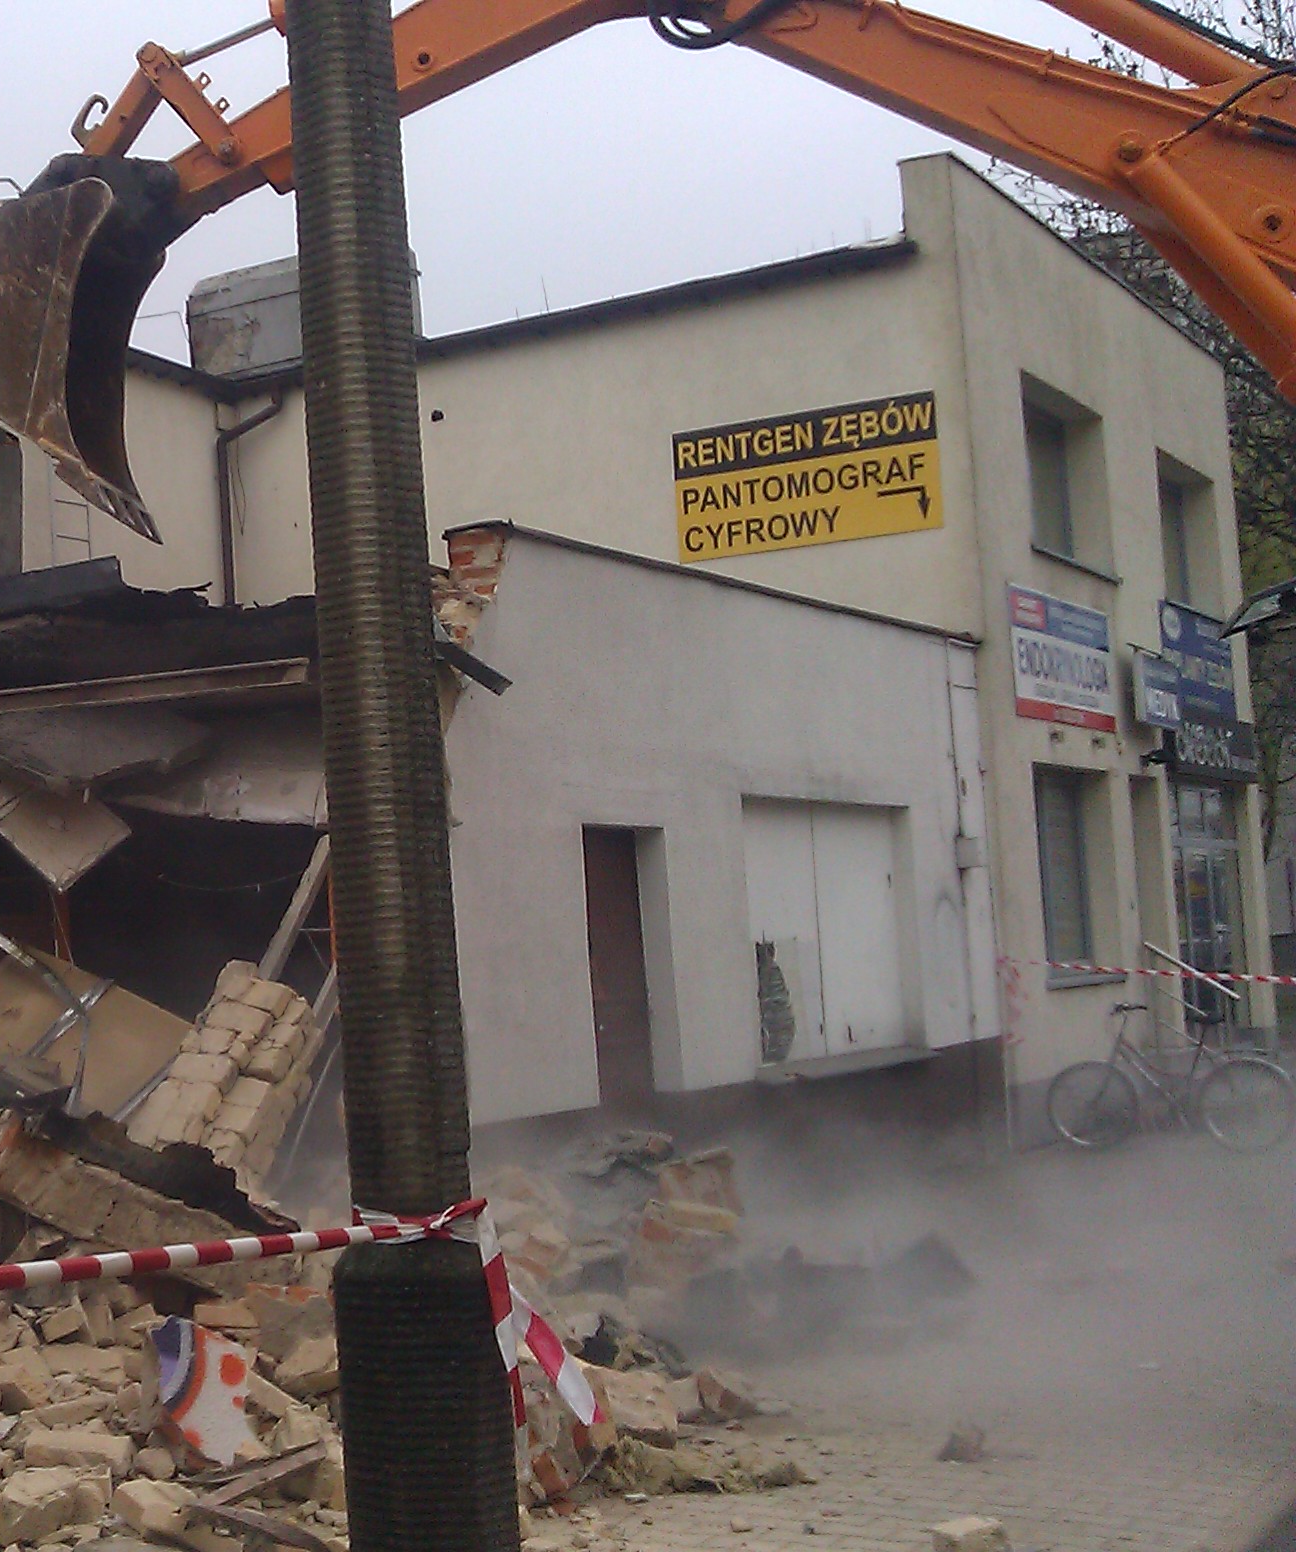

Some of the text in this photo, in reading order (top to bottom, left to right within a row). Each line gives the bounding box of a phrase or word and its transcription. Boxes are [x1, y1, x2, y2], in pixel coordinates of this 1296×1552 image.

[677, 401, 933, 470] RENTGEN ZĘBÓW
[681, 452, 926, 515] PANTOMOGRAF
[684, 506, 841, 553] CYFROWY
